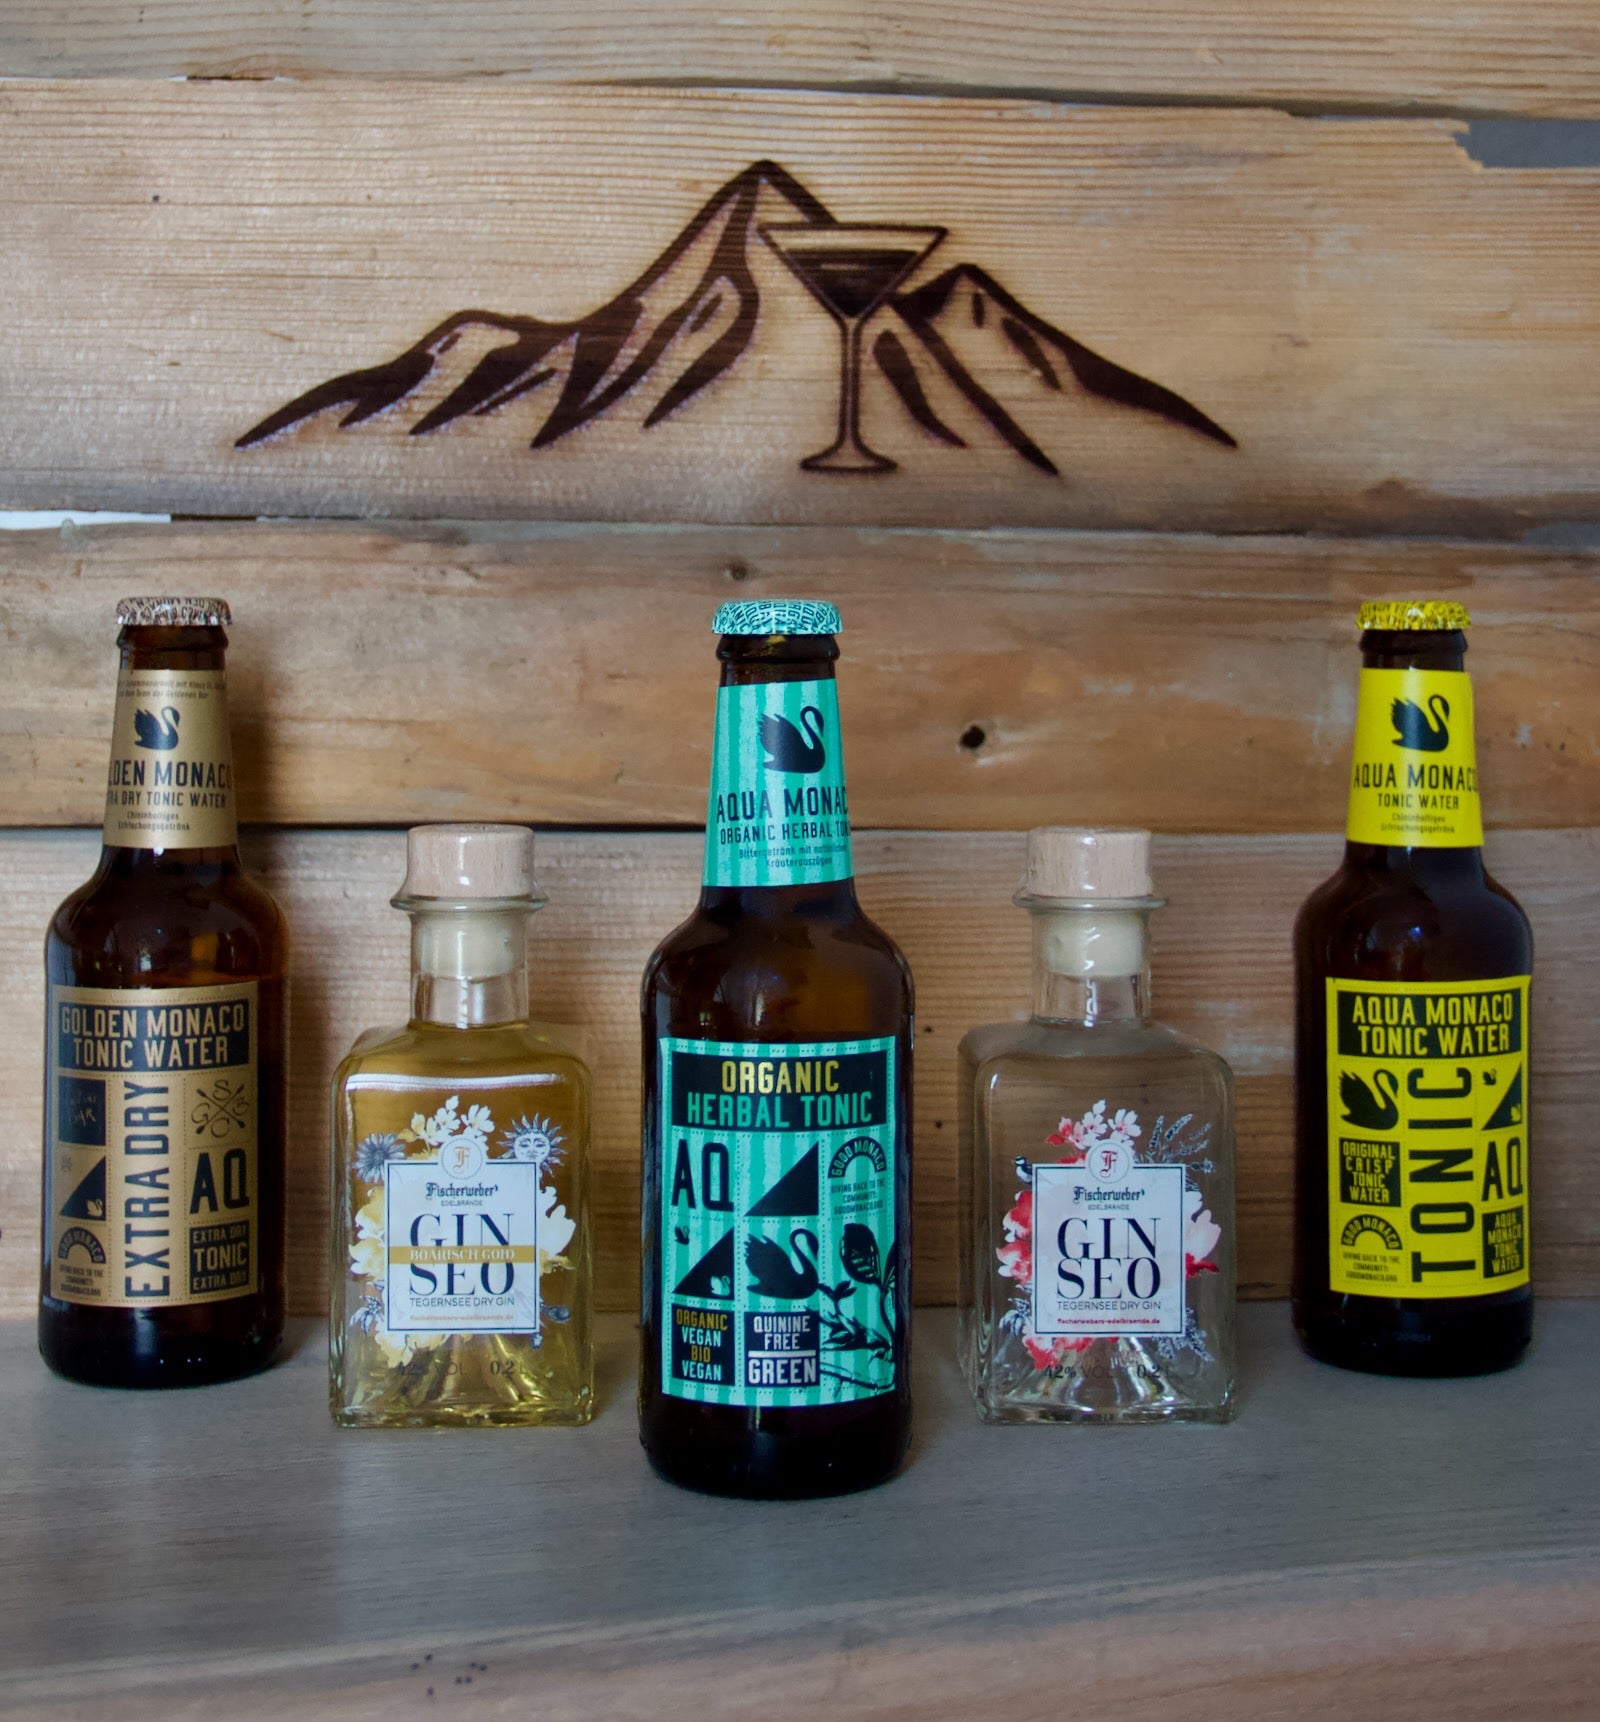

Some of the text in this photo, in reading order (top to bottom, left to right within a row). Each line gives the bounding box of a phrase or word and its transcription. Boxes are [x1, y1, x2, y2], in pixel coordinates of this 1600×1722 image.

[1353, 763, 1397, 788] AQUA
[121, 791, 142, 805] DRY
[146, 791, 184, 806] TONIC
[189, 792, 227, 808] WATER
[716, 789, 773, 823] AQUA
[1378, 794, 1459, 810] TONIC WATER
[720, 824, 776, 845] ORGANIC
[781, 821, 833, 840] HERBAL
[798, 845, 812, 855] mit
[61, 1003, 245, 1039] GOLDEN MONACO
[1352, 993, 1513, 1026] AQUA MONACO
[73, 1035, 229, 1068] TONIC WATER
[1357, 1023, 1509, 1056] TONIC WATER
[721, 1060, 840, 1094] ORGANIC
[687, 1090, 872, 1128] HERBAL TONIC
[830, 1139, 886, 1177] GOOD MONACO
[1342, 1140, 1396, 1160] ORIGINAL
[670, 1137, 735, 1212] AQ
[1345, 1156, 1394, 1175] CRISP
[1406, 1066, 1477, 1283] TONIC
[1481, 1136, 1523, 1202] AQ
[124, 1080, 171, 1297] EXTRA DRY
[189, 1147, 250, 1215] AQ
[1351, 1170, 1387, 1188] TONIC
[1349, 1185, 1391, 1203] WATER
[409, 1212, 515, 1247] GIN
[1494, 1210, 1517, 1229] AQUA
[192, 1227, 227, 1244] EXTRA
[1057, 1216, 1162, 1260] GIN
[1342, 1215, 1400, 1249] GOOD MONACO
[1487, 1223, 1523, 1247] MONACO
[192, 1241, 248, 1273] TONIC
[409, 1248, 516, 1261] BOARISCH GOLD
[1491, 1253, 1521, 1275] WATER
[192, 1273, 227, 1291] EXTRA
[408, 1262, 515, 1297] SEO
[1056, 1256, 1162, 1301] SEO
[408, 1296, 516, 1308] TEGERNSEE DRY GIN
[1056, 1300, 1162, 1311] TEGERNSEE DRY GIN
[675, 1308, 729, 1331] ORGANIC
[753, 1315, 811, 1334] QUININE
[681, 1326, 722, 1347] VEGAN
[764, 1332, 801, 1351] FREE
[691, 1345, 711, 1363] BIO
[681, 1360, 722, 1381] VEGAN
[747, 1357, 817, 1385] GREEN
